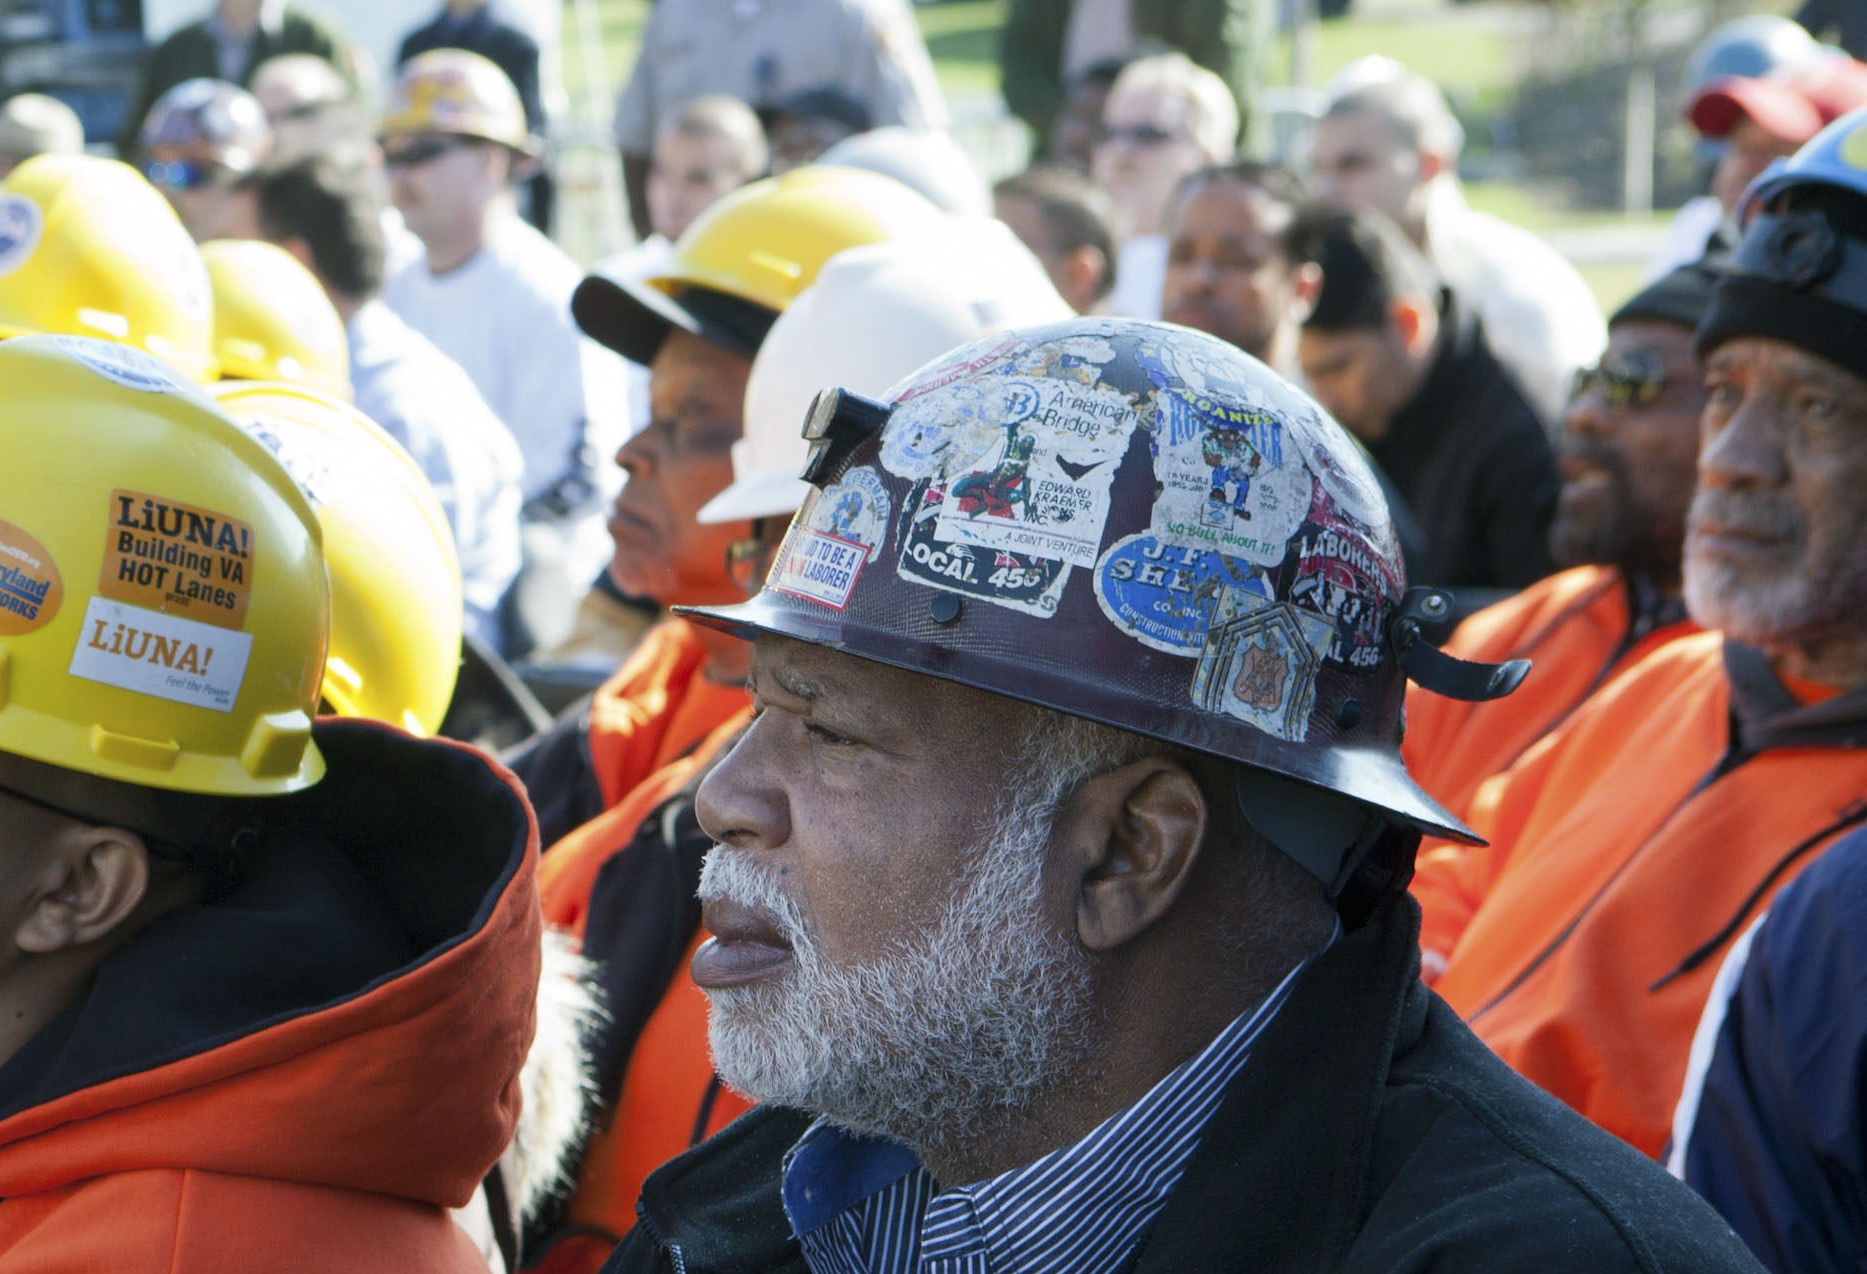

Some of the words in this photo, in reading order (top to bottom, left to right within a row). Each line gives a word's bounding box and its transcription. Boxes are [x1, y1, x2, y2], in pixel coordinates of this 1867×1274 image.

[1043, 408, 1101, 441] Bridge
[1049, 391, 1137, 426] American
[1034, 491, 1092, 512] KRAEMER
[1039, 480, 1091, 499] EDWARD
[117, 496, 248, 559] LiUNA!
[1167, 522, 1185, 534] NO
[1221, 534, 1258, 550] ABOUT
[1261, 540, 1276, 556] IT!
[117, 530, 212, 579] Building
[220, 556, 244, 585] VA
[818, 539, 832, 561] TO
[830, 546, 847, 567] BE
[845, 551, 857, 570] A
[1014, 533, 1042, 547] JOINT
[1047, 538, 1094, 558] VENTURE
[803, 560, 850, 591] LABORER
[903, 541, 978, 584] LOCAL
[118, 558, 169, 589] HOT
[174, 571, 236, 611] Lanes
[1119, 603, 1183, 641] CONSTRUCTION
[88, 619, 214, 676] LiUNA!
[1349, 646, 1380, 667] 456
[165, 675, 184, 690] Feel
[186, 677, 205, 692] the
[203, 683, 230, 698] Power
